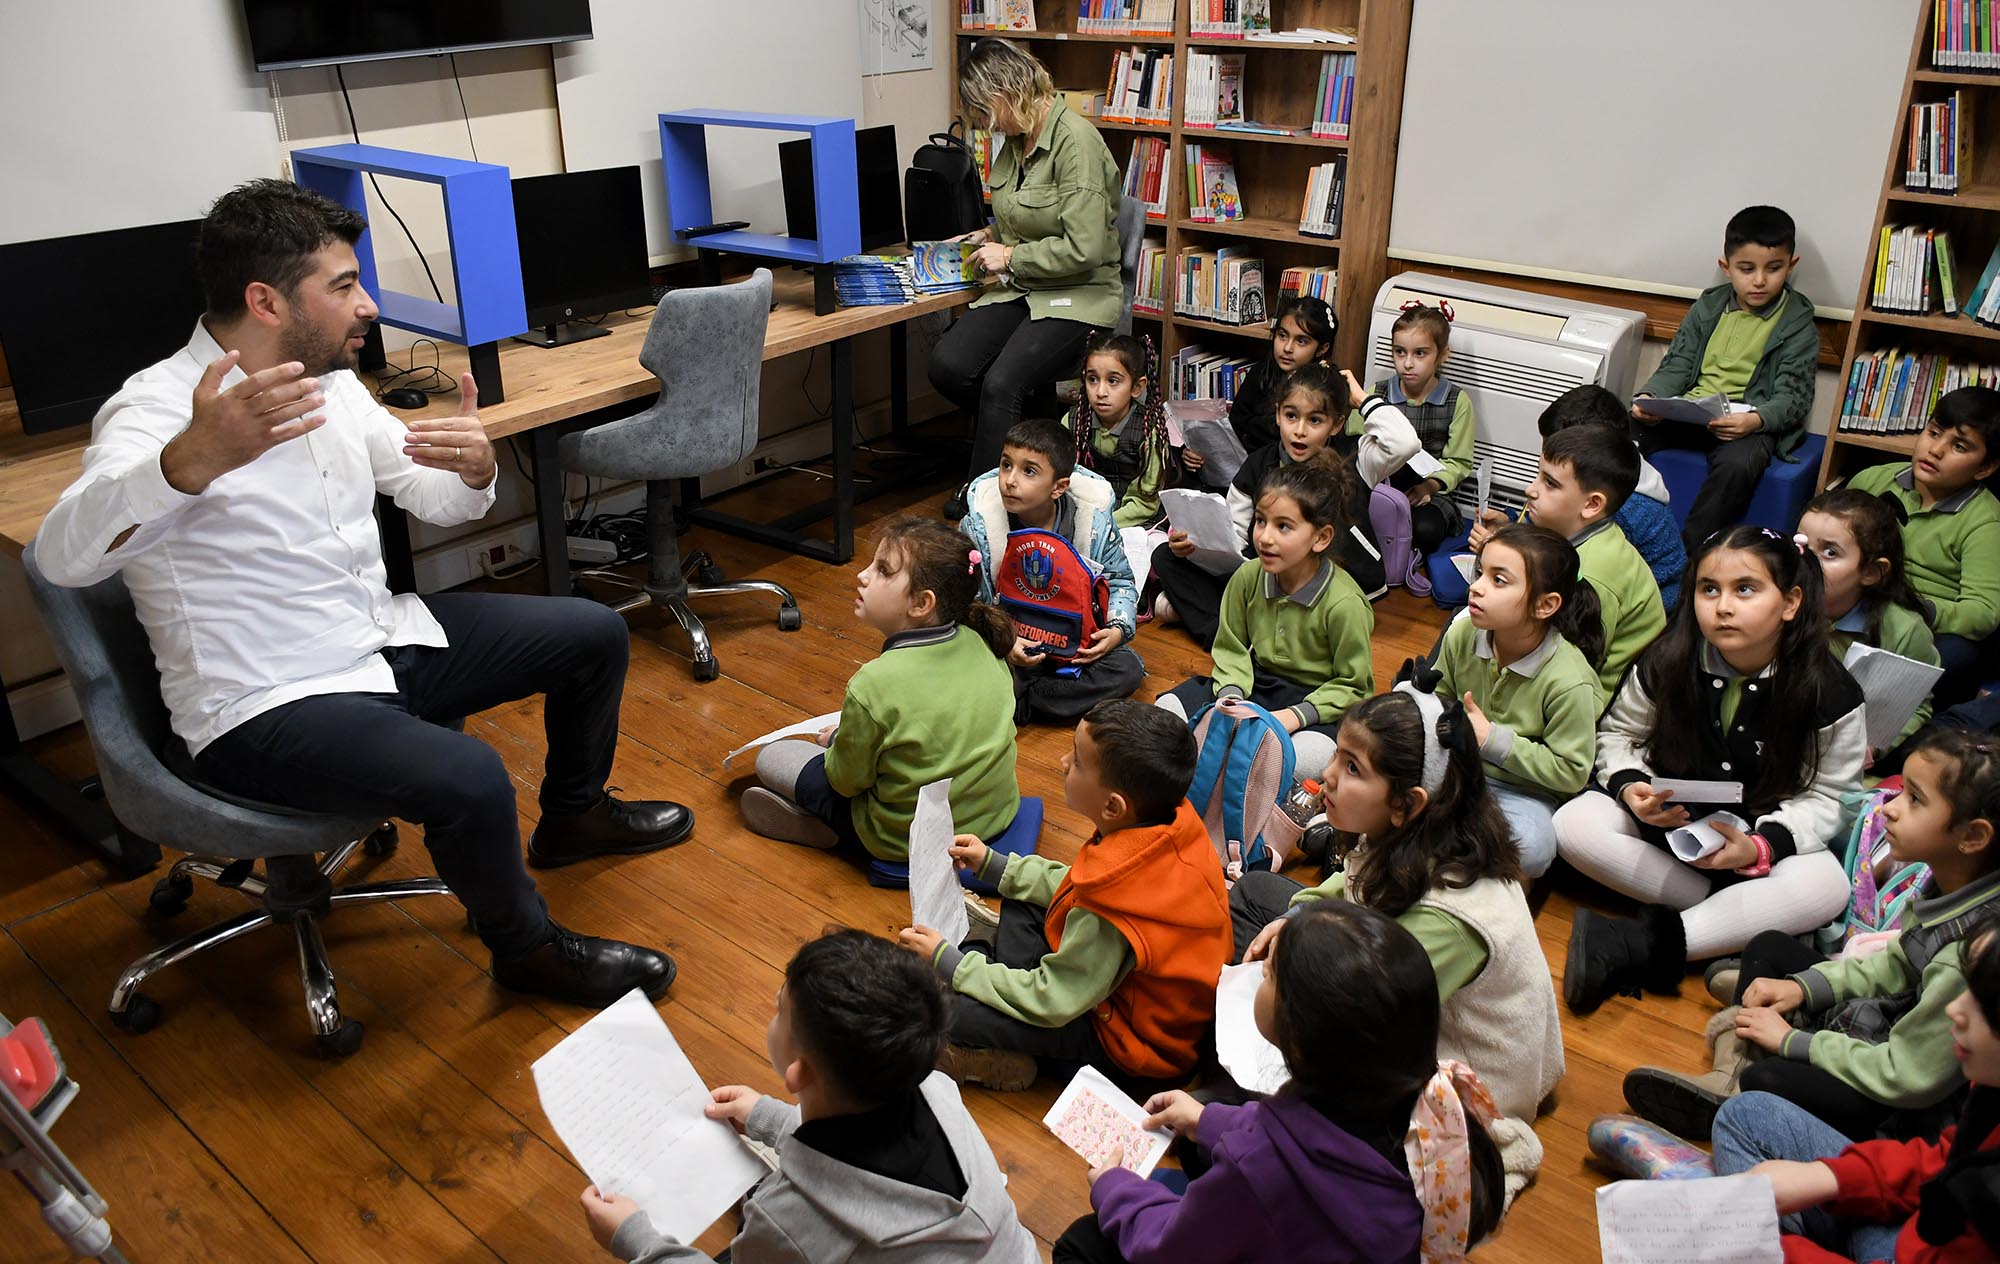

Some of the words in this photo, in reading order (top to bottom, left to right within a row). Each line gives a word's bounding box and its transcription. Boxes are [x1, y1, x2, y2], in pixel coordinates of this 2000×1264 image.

[1016, 541, 1035, 553] MORE
[1039, 541, 1056, 554] THAN
[1035, 594, 1051, 602] THE
[1013, 620, 1069, 649] NSFORMERS
